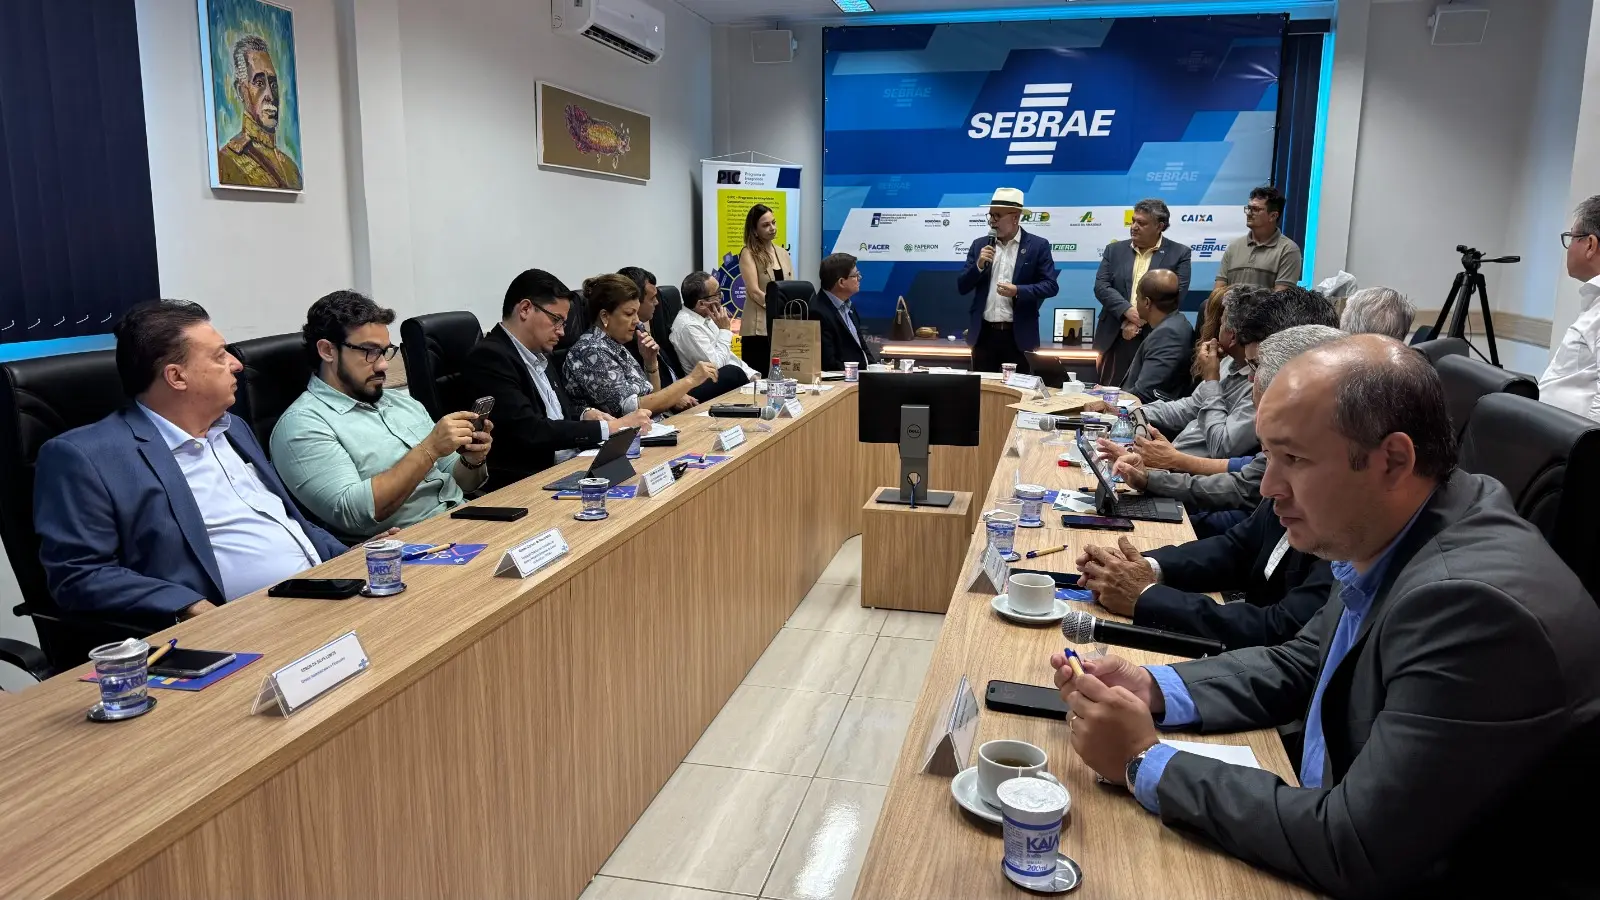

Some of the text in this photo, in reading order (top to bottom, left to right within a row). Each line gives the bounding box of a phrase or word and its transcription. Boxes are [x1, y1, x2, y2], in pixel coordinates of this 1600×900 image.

[882, 87, 932, 98] SEBRAE
[968, 110, 1115, 139] SEBRAE
[717, 170, 741, 184] PIC
[1146, 171, 1199, 182] SEBRAE
[1181, 214, 1213, 222] CAIXA
[1026, 864, 1048, 872] 200ml
